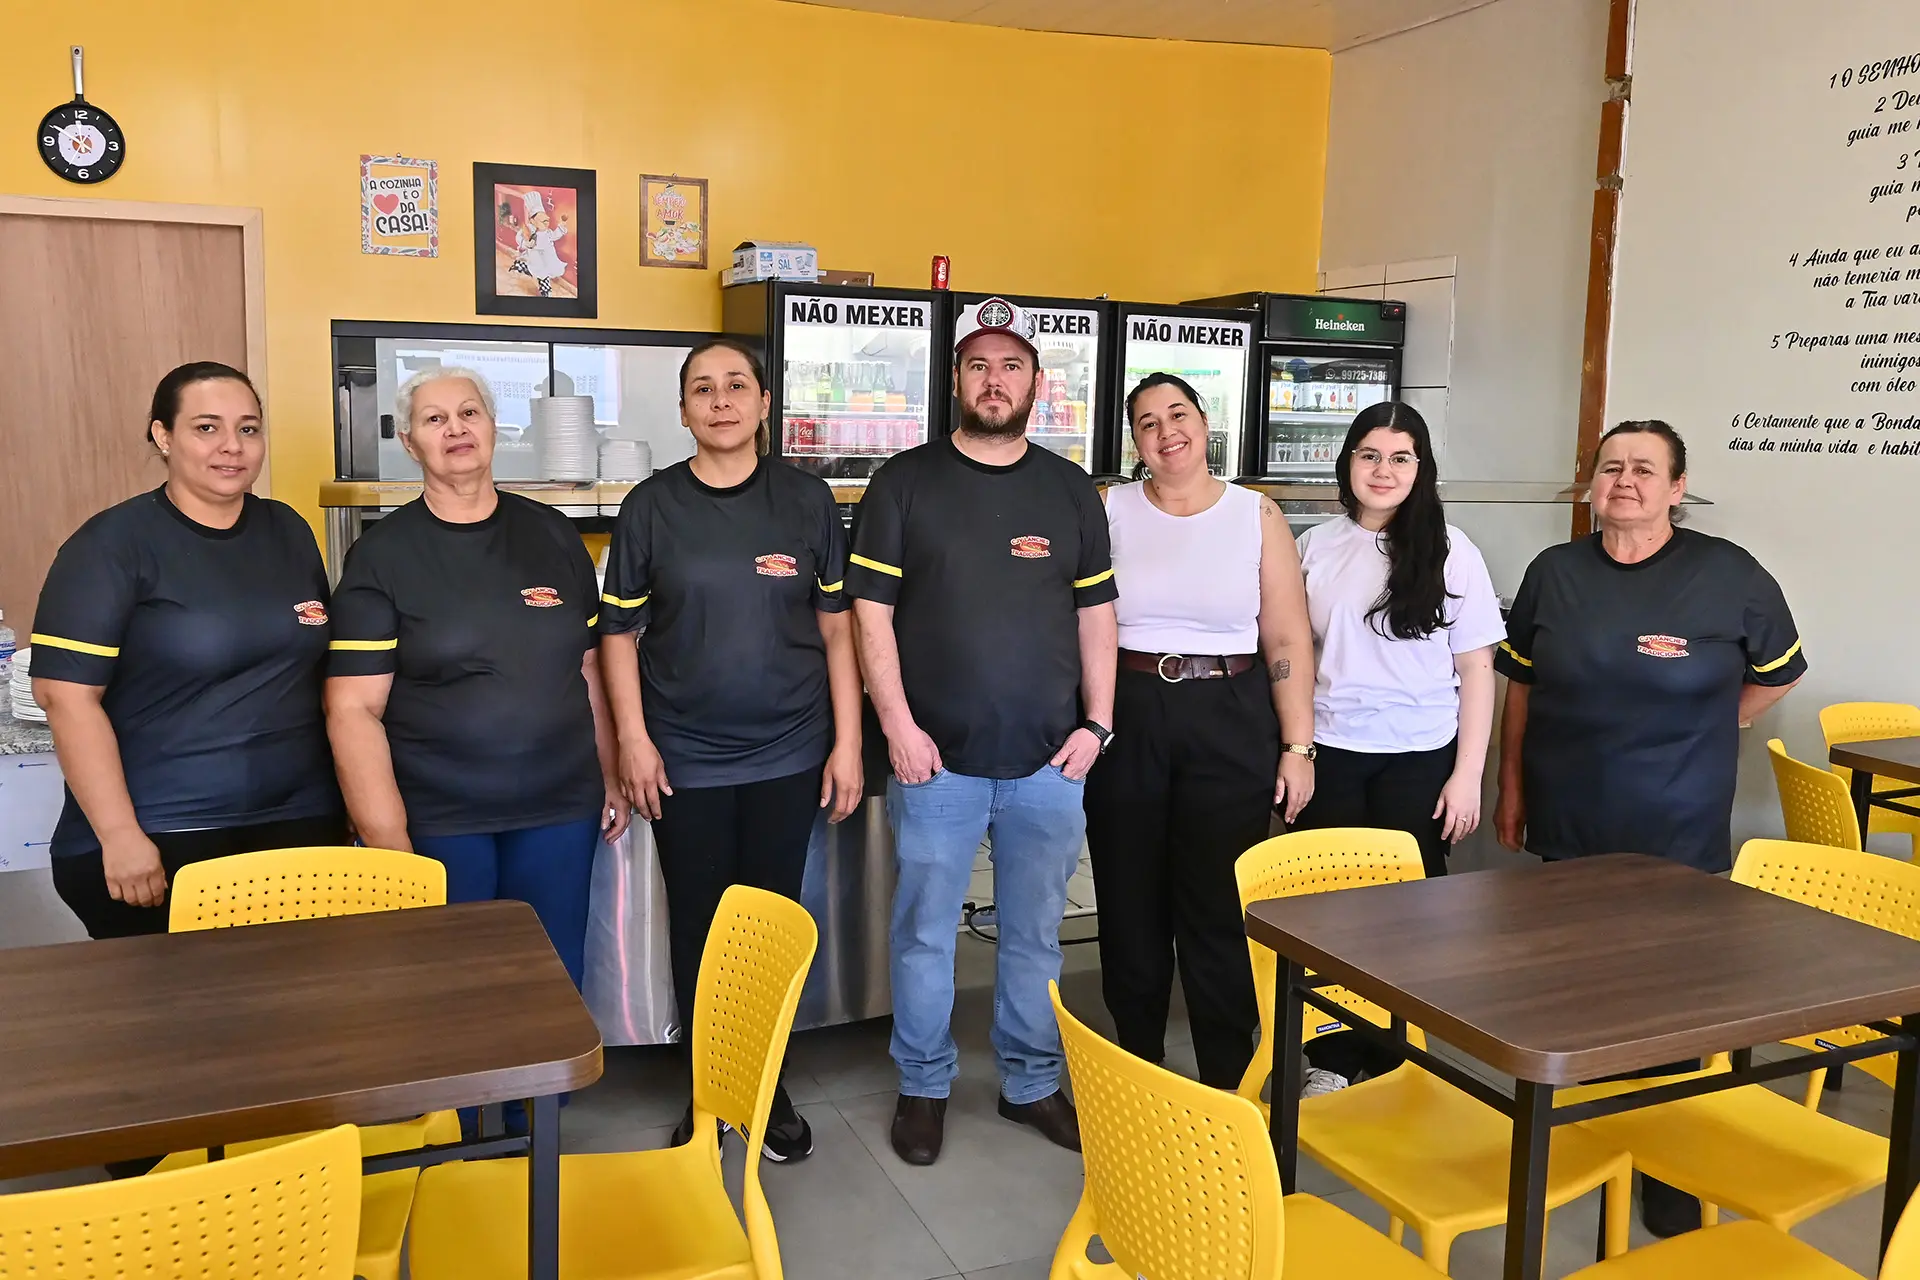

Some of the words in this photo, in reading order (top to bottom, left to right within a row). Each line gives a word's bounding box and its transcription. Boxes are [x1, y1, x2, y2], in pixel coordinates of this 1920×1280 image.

[1829, 73, 1838, 89] 1
[1874, 96, 1887, 113] 2
[74, 110, 88, 119] 12
[43, 136, 55, 147] 9
[1846, 122, 1881, 147] guia
[1887, 120, 1912, 135] me
[108, 141, 119, 151] 3
[1896, 153, 1909, 170] 3
[77, 169, 89, 179] 6
[370, 180, 377, 190] A
[380, 178, 421, 189] COZINHA
[1868, 179, 1904, 203] guia
[411, 190, 419, 199] O
[400, 201, 415, 213] DA
[376, 213, 428, 234] CASA!
[778, 258, 792, 270] SAL
[1789, 252, 1799, 267] 4
[1802, 248, 1848, 267] Ainda
[1853, 248, 1880, 266] que
[1885, 245, 1904, 258] eu
[1844, 267, 1901, 286] temeria
[1845, 297, 1856, 309] a
[1862, 290, 1888, 309] Tua
[791, 298, 838, 324] NÃO
[846, 304, 924, 327] MEXER
[1032, 313, 1091, 335] EXER
[1132, 318, 1172, 343] NÃO
[1177, 325, 1244, 347] MEXER
[1315, 318, 1365, 332] Heineken
[1770, 334, 1781, 349] 5
[1785, 331, 1851, 352] Preparas
[1854, 333, 1889, 346] uma
[1850, 381, 1882, 393] com
[1886, 376, 1917, 393] óleo
[1731, 413, 1741, 428] 6
[1744, 412, 1819, 429] Certamente
[1824, 418, 1850, 434] que
[1855, 418, 1865, 429] a
[1728, 437, 1754, 451] dias
[1759, 438, 1775, 451] da
[1780, 438, 1823, 453] minha
[1828, 439, 1858, 454] vida
[1867, 443, 1877, 455] e
[1637, 645, 1689, 658] TRADICIONAL
